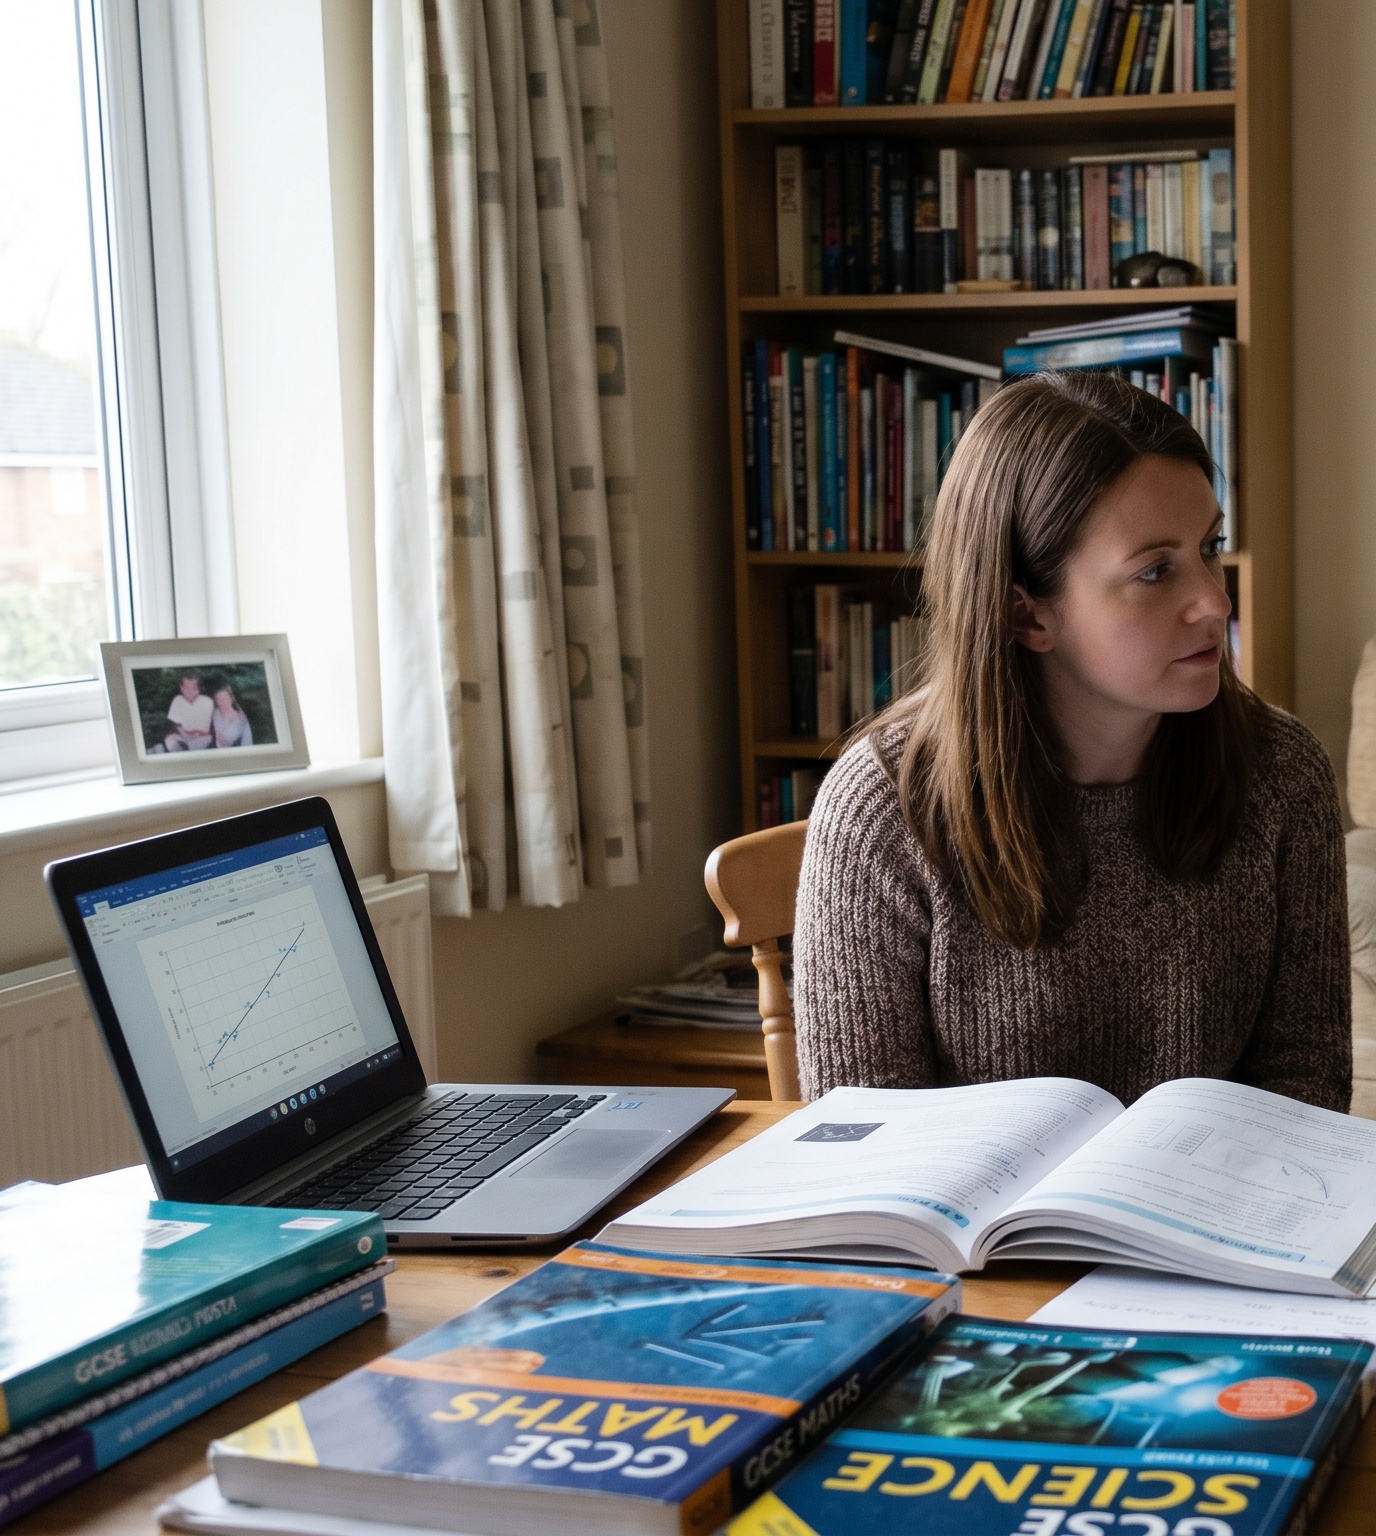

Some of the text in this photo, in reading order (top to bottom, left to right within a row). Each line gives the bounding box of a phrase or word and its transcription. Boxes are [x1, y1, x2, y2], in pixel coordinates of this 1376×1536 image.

[74, 1343, 127, 1384] GCSE
[430, 1391, 739, 1446] MATHS
[744, 1373, 861, 1488] GCSE MATHS
[488, 1434, 689, 1479] GCSE
[821, 1451, 1260, 1515] SCIENCE
